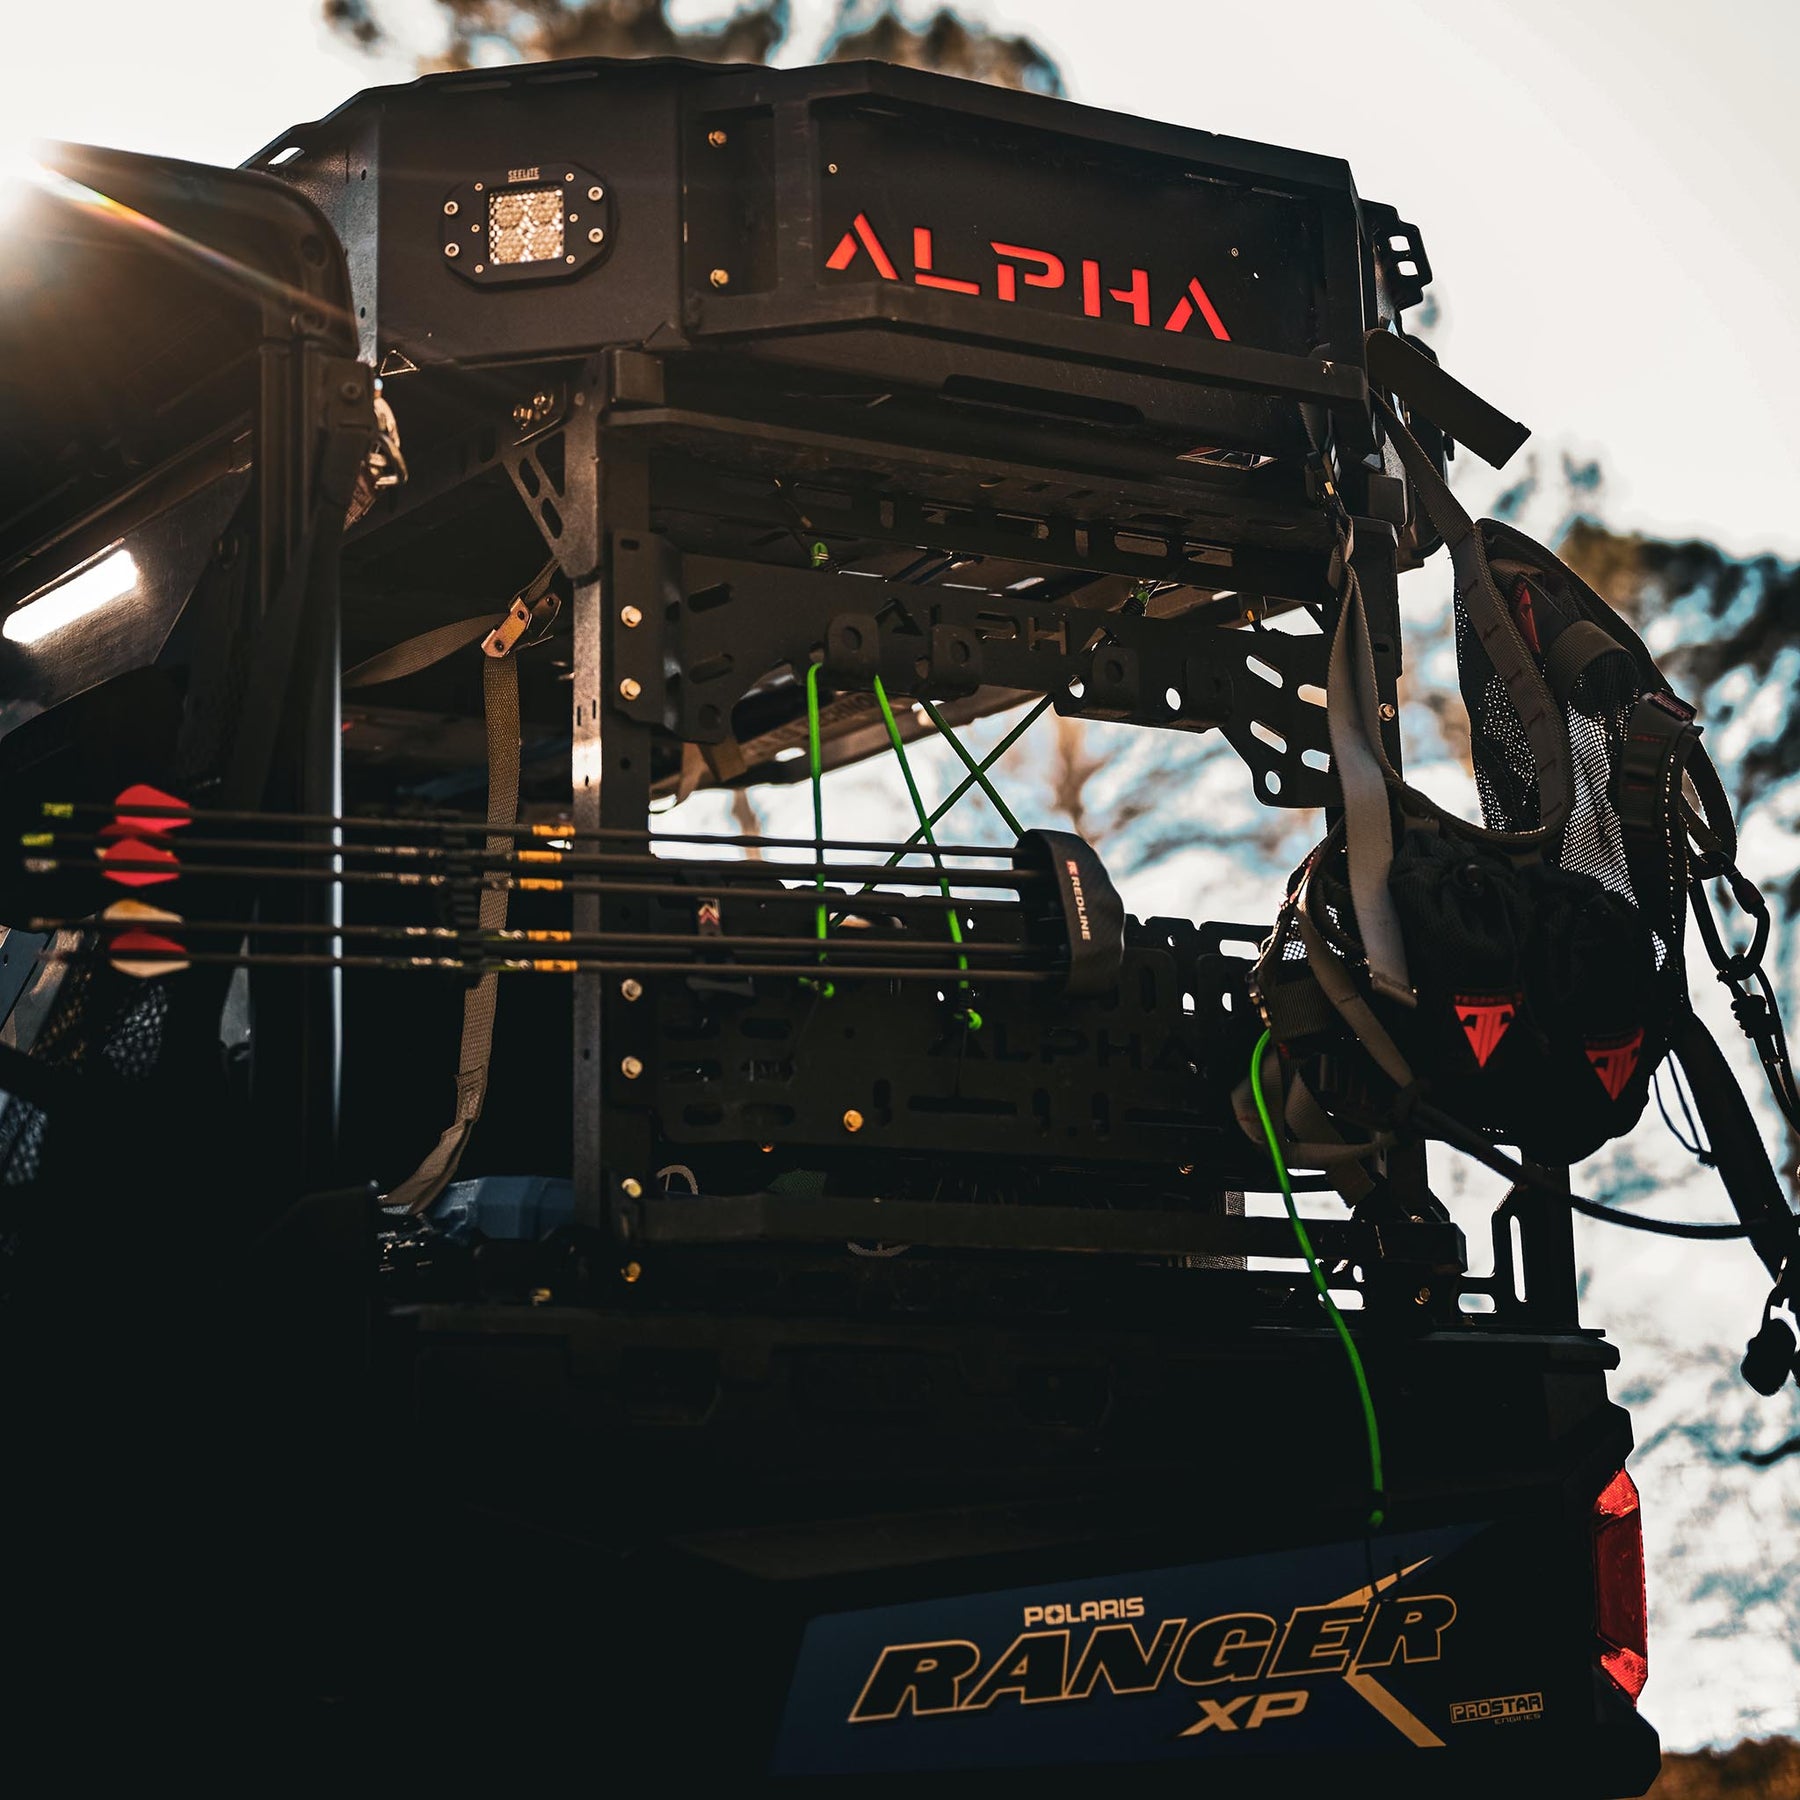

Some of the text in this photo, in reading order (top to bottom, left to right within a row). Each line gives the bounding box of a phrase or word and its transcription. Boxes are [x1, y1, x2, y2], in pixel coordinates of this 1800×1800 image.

[826, 213, 1231, 342] ALPHA
[1070, 875, 1092, 942] REDLINE
[1023, 1596, 1145, 1628] POLARIS
[847, 1594, 1457, 1724] RANGER
[1177, 1690, 1310, 1737] XP
[1450, 1692, 1544, 1723] PROSTAR
